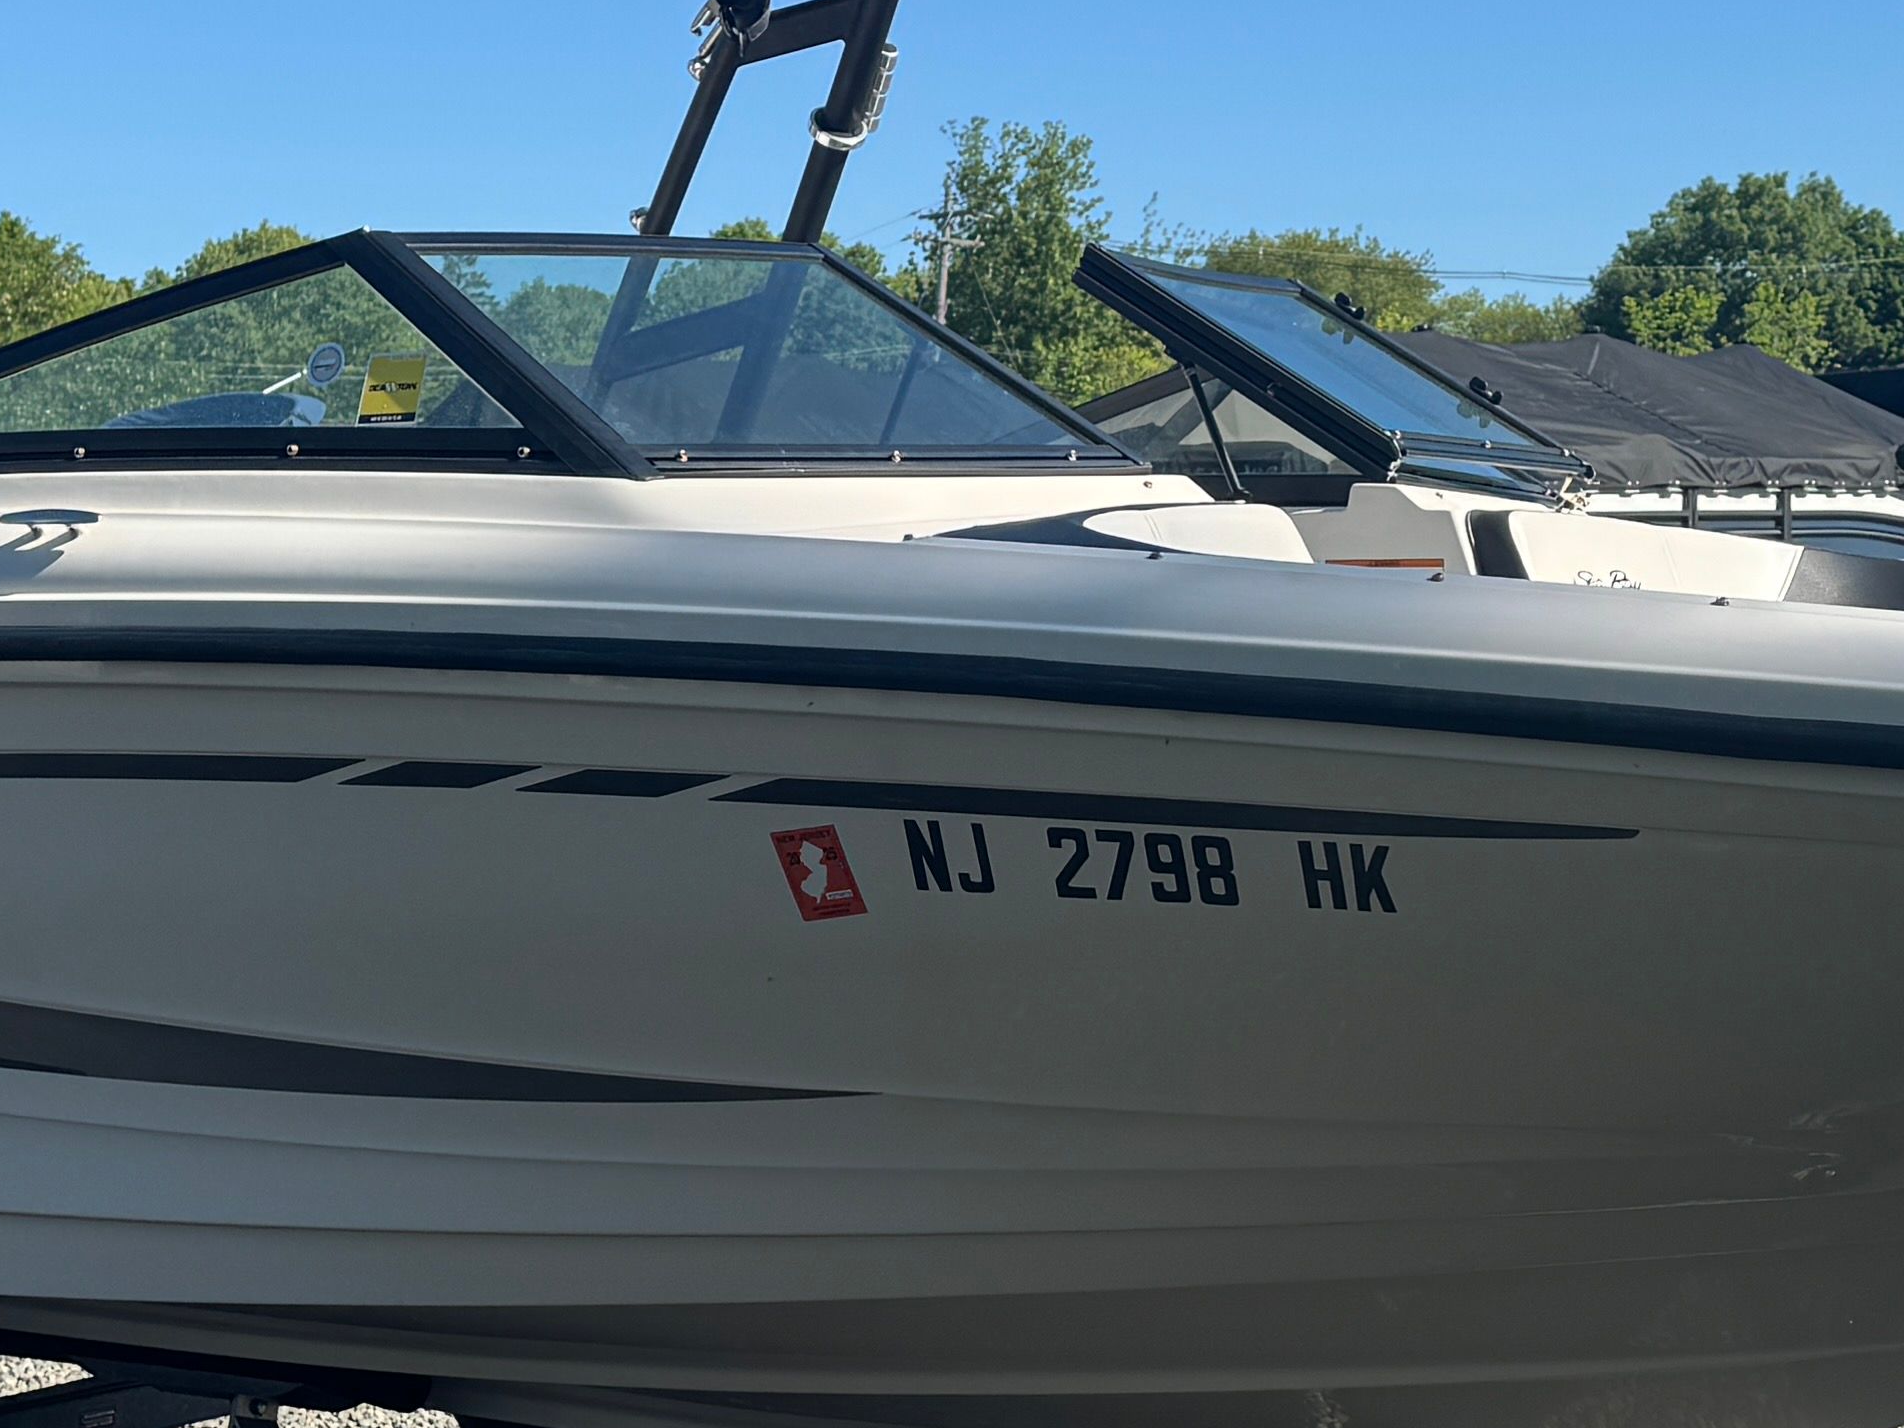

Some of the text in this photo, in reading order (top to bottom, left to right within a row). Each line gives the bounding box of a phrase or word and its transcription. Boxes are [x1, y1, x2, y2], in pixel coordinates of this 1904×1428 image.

[902, 818, 1398, 914] NJ 2798 HK
